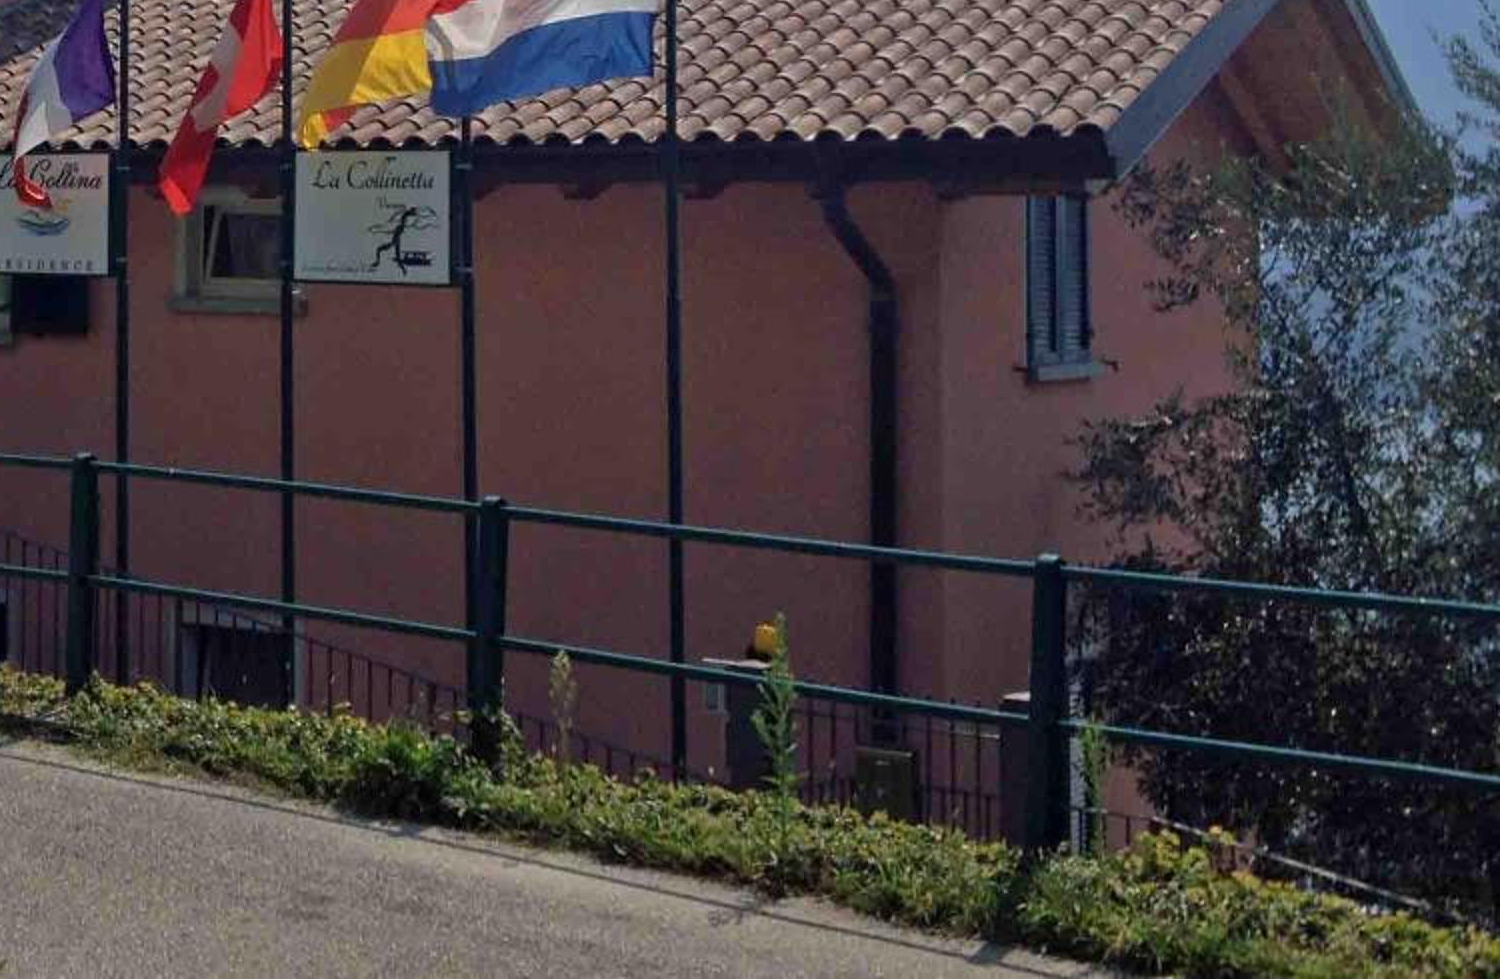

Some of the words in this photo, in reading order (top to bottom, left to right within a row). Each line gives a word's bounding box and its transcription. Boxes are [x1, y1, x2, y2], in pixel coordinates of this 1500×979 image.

[29, 158, 102, 190] Collina
[310, 160, 340, 190] La
[346, 156, 436, 190] Collinetta
